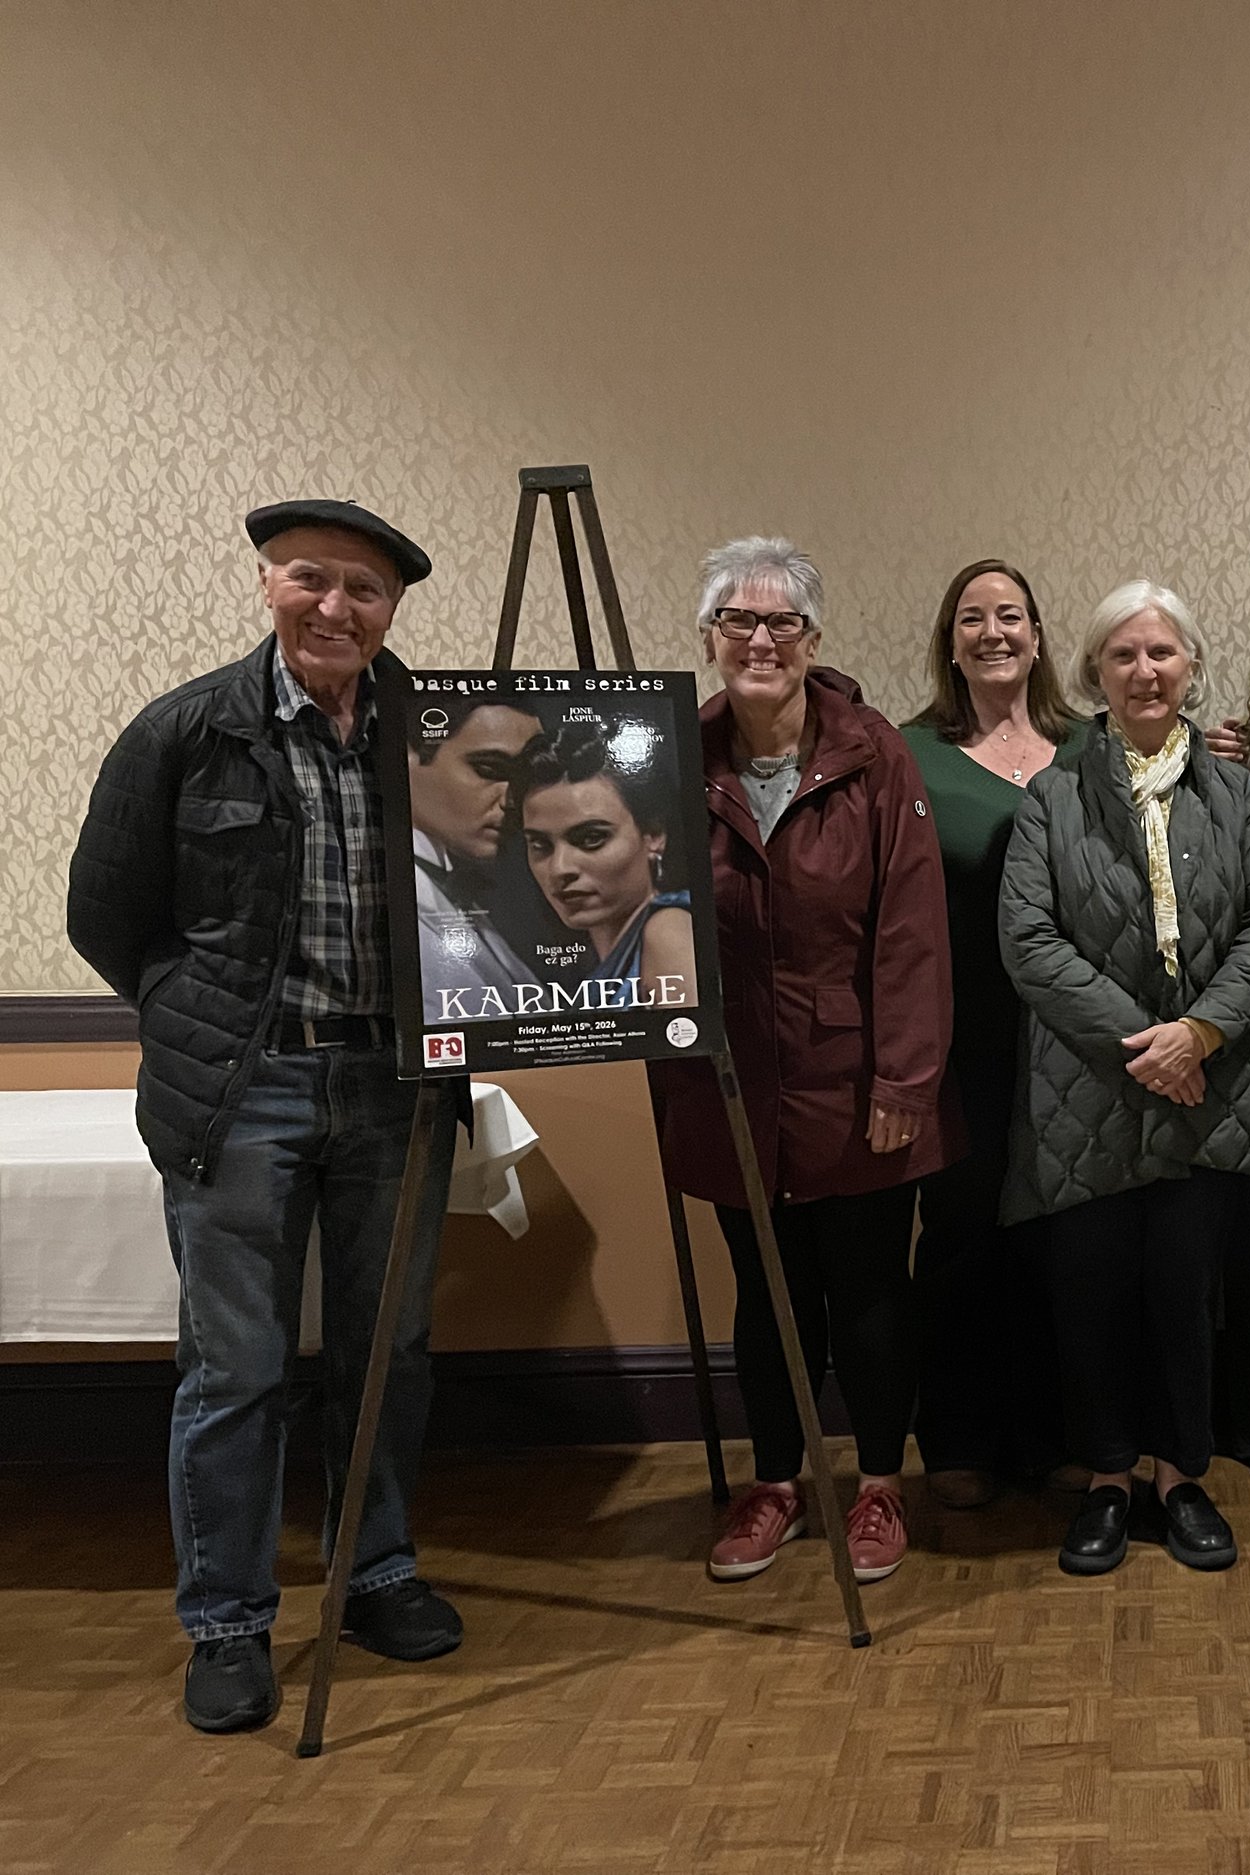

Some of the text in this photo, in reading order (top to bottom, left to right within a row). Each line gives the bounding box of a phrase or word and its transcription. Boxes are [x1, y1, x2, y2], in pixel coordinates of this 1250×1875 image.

[411, 675, 665, 695] basque film series
[569, 706, 594, 715] JONE
[562, 714, 602, 722] LASPIUR
[421, 729, 449, 738] SSIFF
[536, 942, 586, 957] Baga edo
[545, 953, 578, 967] ez ga?
[436, 974, 687, 1020] KARMELE
[518, 1026, 550, 1035] Friday,
[551, 1024, 572, 1033] May
[594, 1020, 616, 1030] 2026
